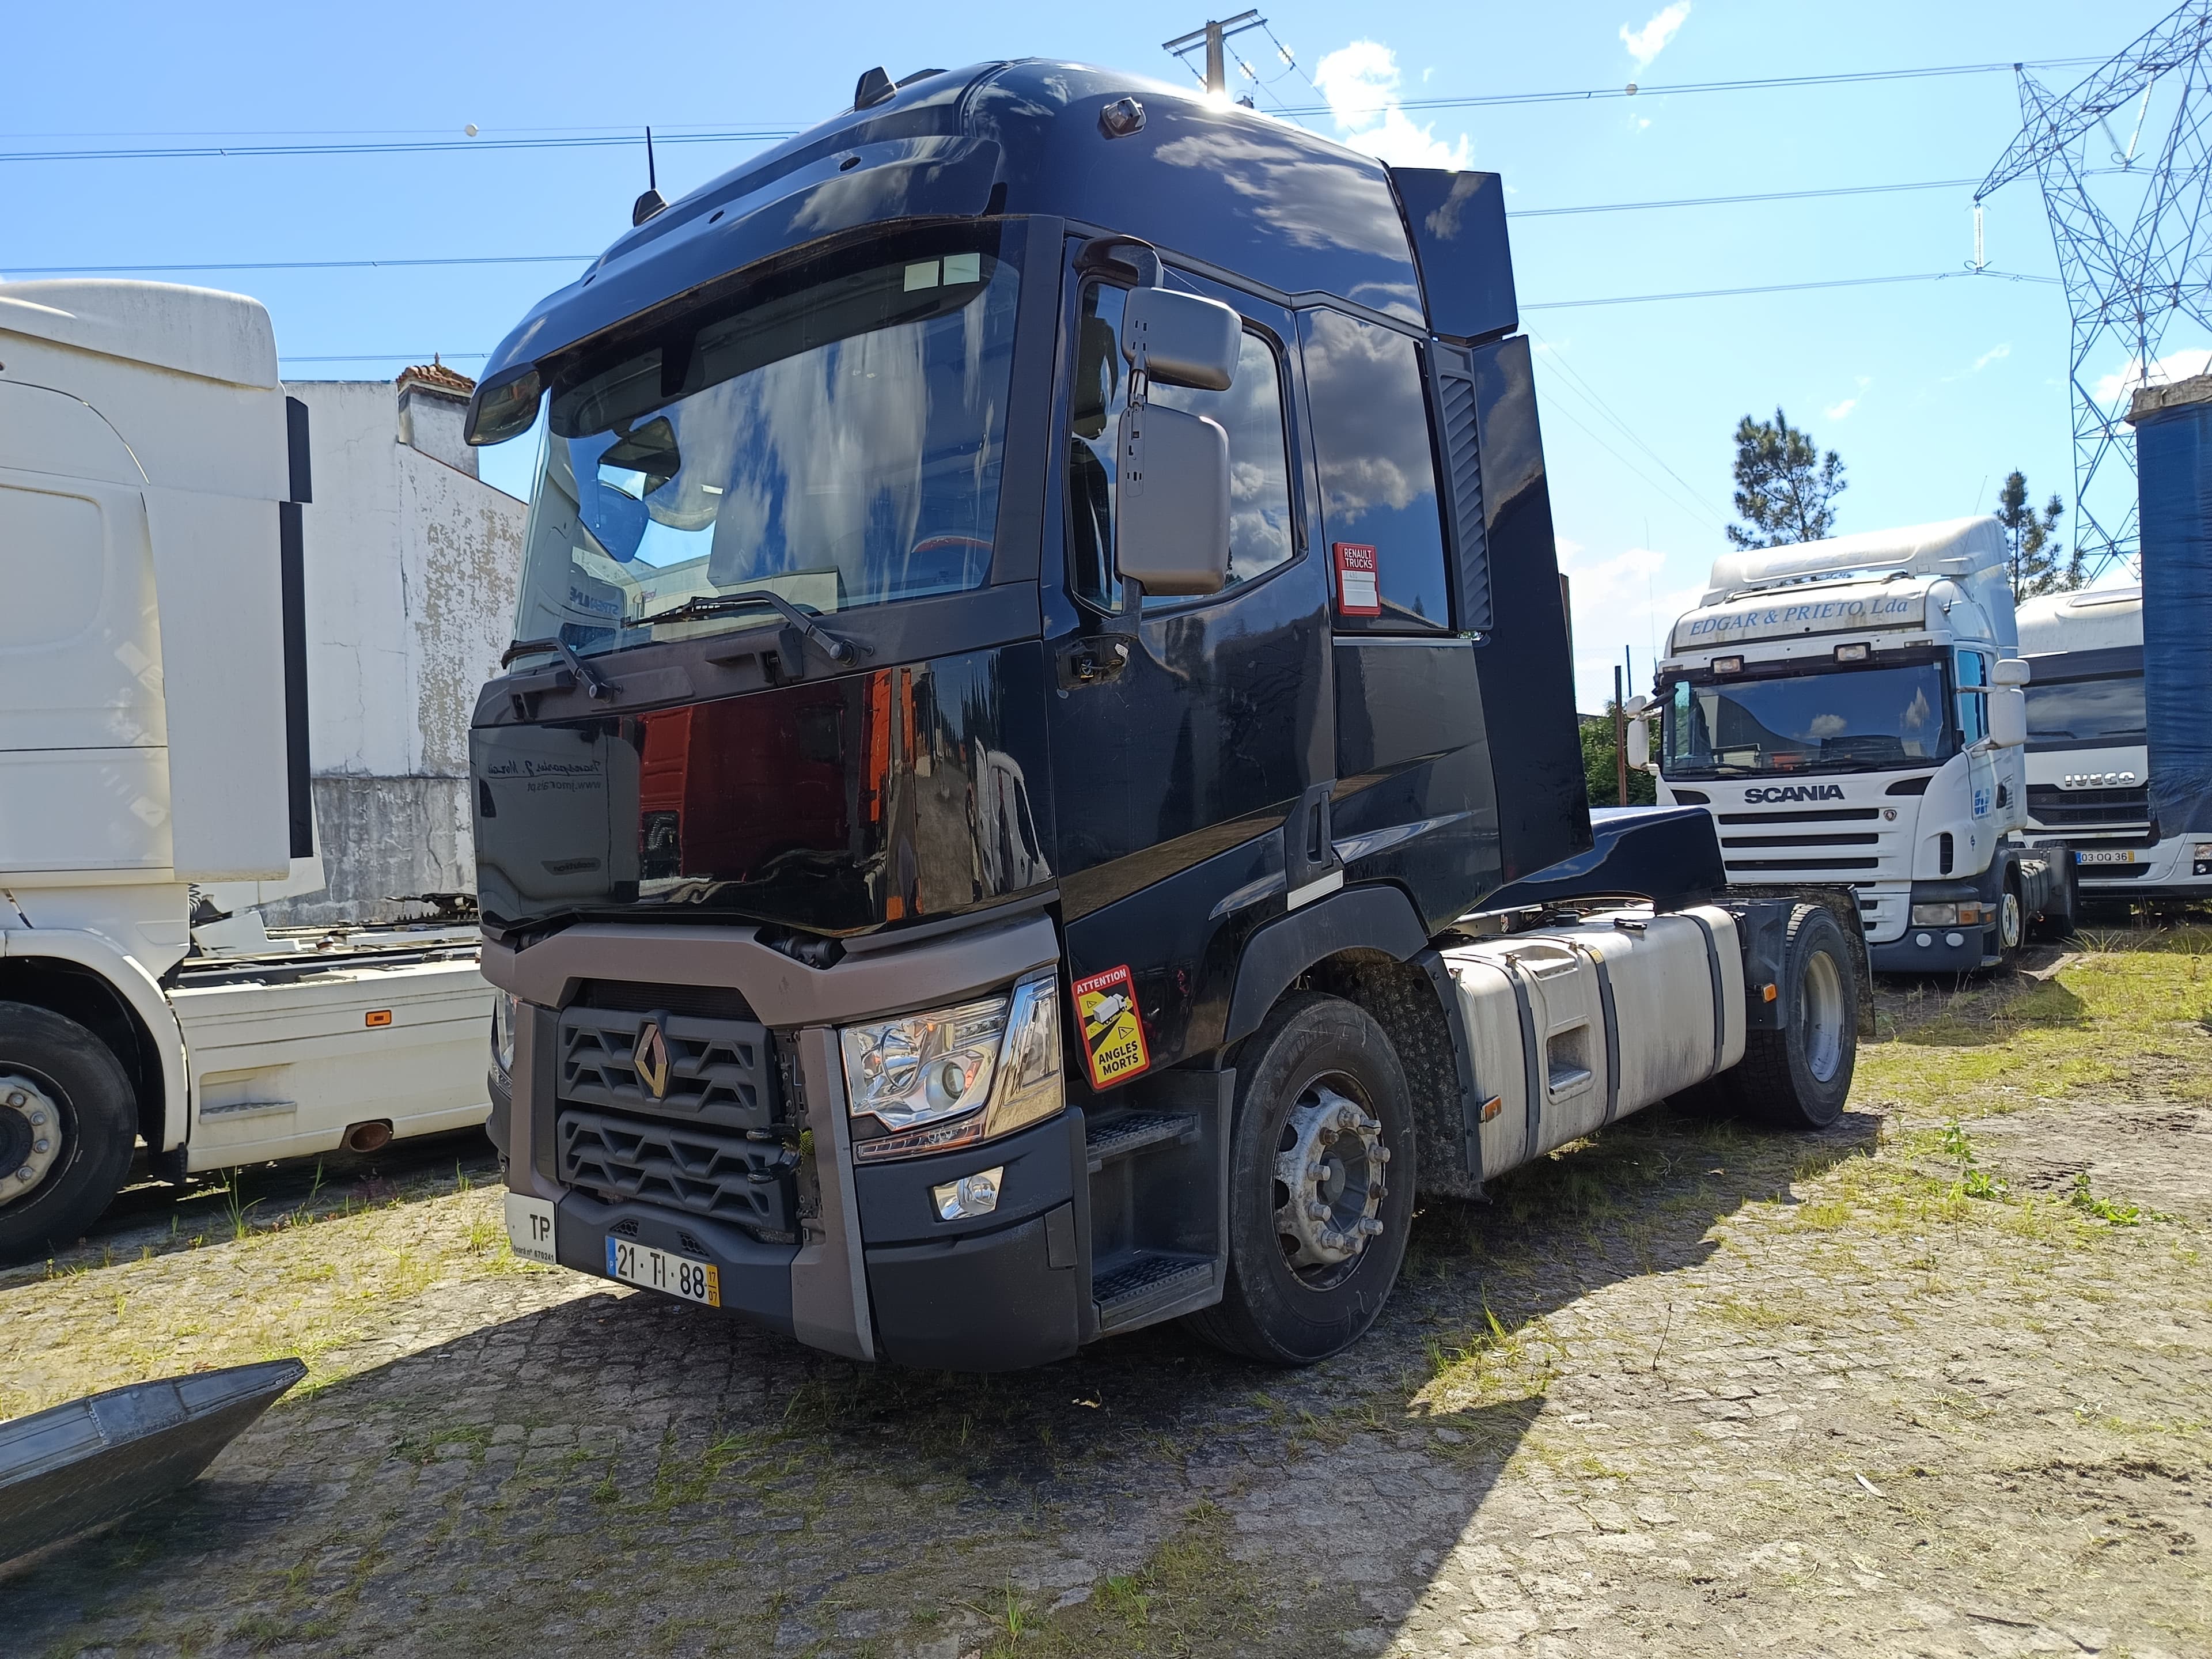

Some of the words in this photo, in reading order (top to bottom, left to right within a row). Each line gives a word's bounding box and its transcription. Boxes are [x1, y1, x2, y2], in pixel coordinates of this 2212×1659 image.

[1344, 548, 1372, 559] RENAULT
[1345, 558, 1373, 569] TRUCKS
[1690, 612, 1758, 636] EDGAR
[1764, 609, 1778, 624] &
[1870, 599, 1908, 614] Lda
[2065, 771, 2135, 787] IVECO
[1744, 785, 1845, 804] SCANIA
[1077, 968, 1127, 994] ATTENTION
[1099, 1040, 1138, 1065] ANGLES
[1103, 1053, 1139, 1075] MORTS
[530, 1214, 550, 1241] TP
[534, 1250, 554, 1262] 670241
[709, 1271, 716, 1283] 17
[709, 1290, 717, 1302] 07
